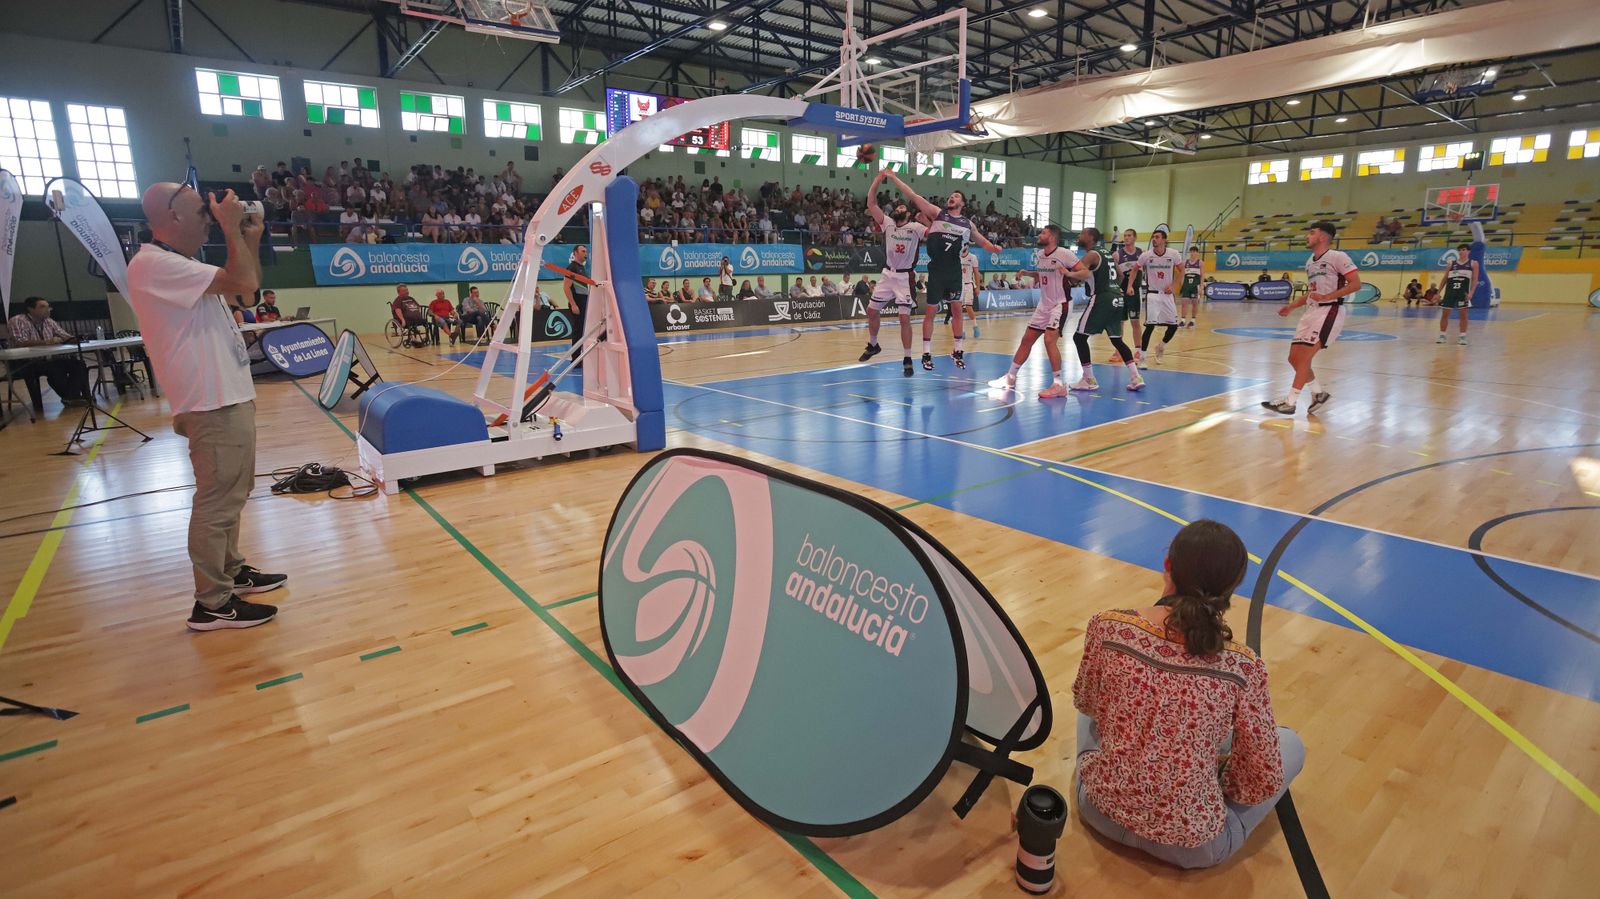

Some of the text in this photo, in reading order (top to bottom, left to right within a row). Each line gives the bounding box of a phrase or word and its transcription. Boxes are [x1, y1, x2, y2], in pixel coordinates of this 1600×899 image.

[692, 135, 704, 145] 53
[562, 190, 579, 211] ACE
[895, 243, 906, 254] 32
[944, 242, 952, 252] 7
[368, 251, 430, 263] baloncesto
[1452, 282, 1461, 290] 23
[791, 300, 826, 310] Diputación
[694, 307, 716, 315] BASKET
[694, 313, 735, 323] SOSTENIBLE
[280, 335, 326, 354] Ayuntamiento
[293, 353, 304, 363] de
[303, 350, 313, 360] La
[796, 532, 929, 624] baloncesto
[785, 571, 909, 657] andalucía
